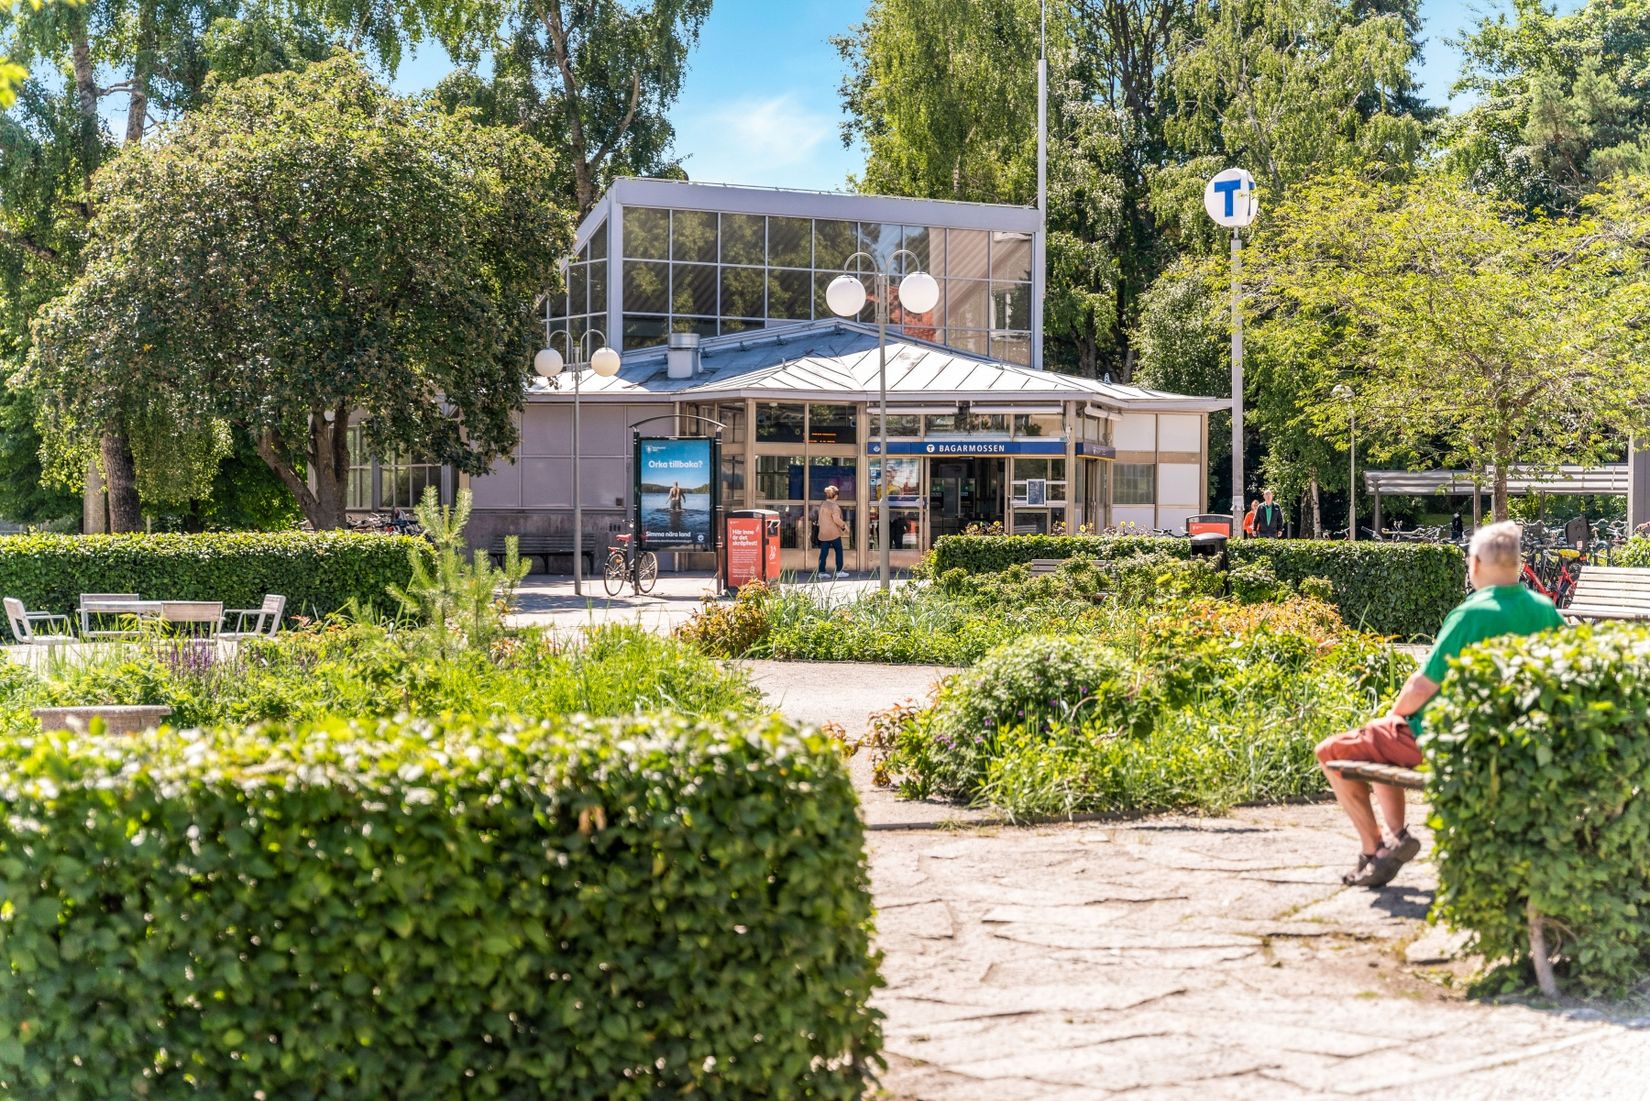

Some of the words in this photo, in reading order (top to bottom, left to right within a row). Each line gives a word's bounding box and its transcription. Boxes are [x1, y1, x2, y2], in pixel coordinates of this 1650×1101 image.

[1214, 179, 1241, 217] T
[939, 444, 1005, 452] BAGARMOSSEN
[648, 460, 668, 468] Orka
[669, 460, 703, 468] tillbaka?
